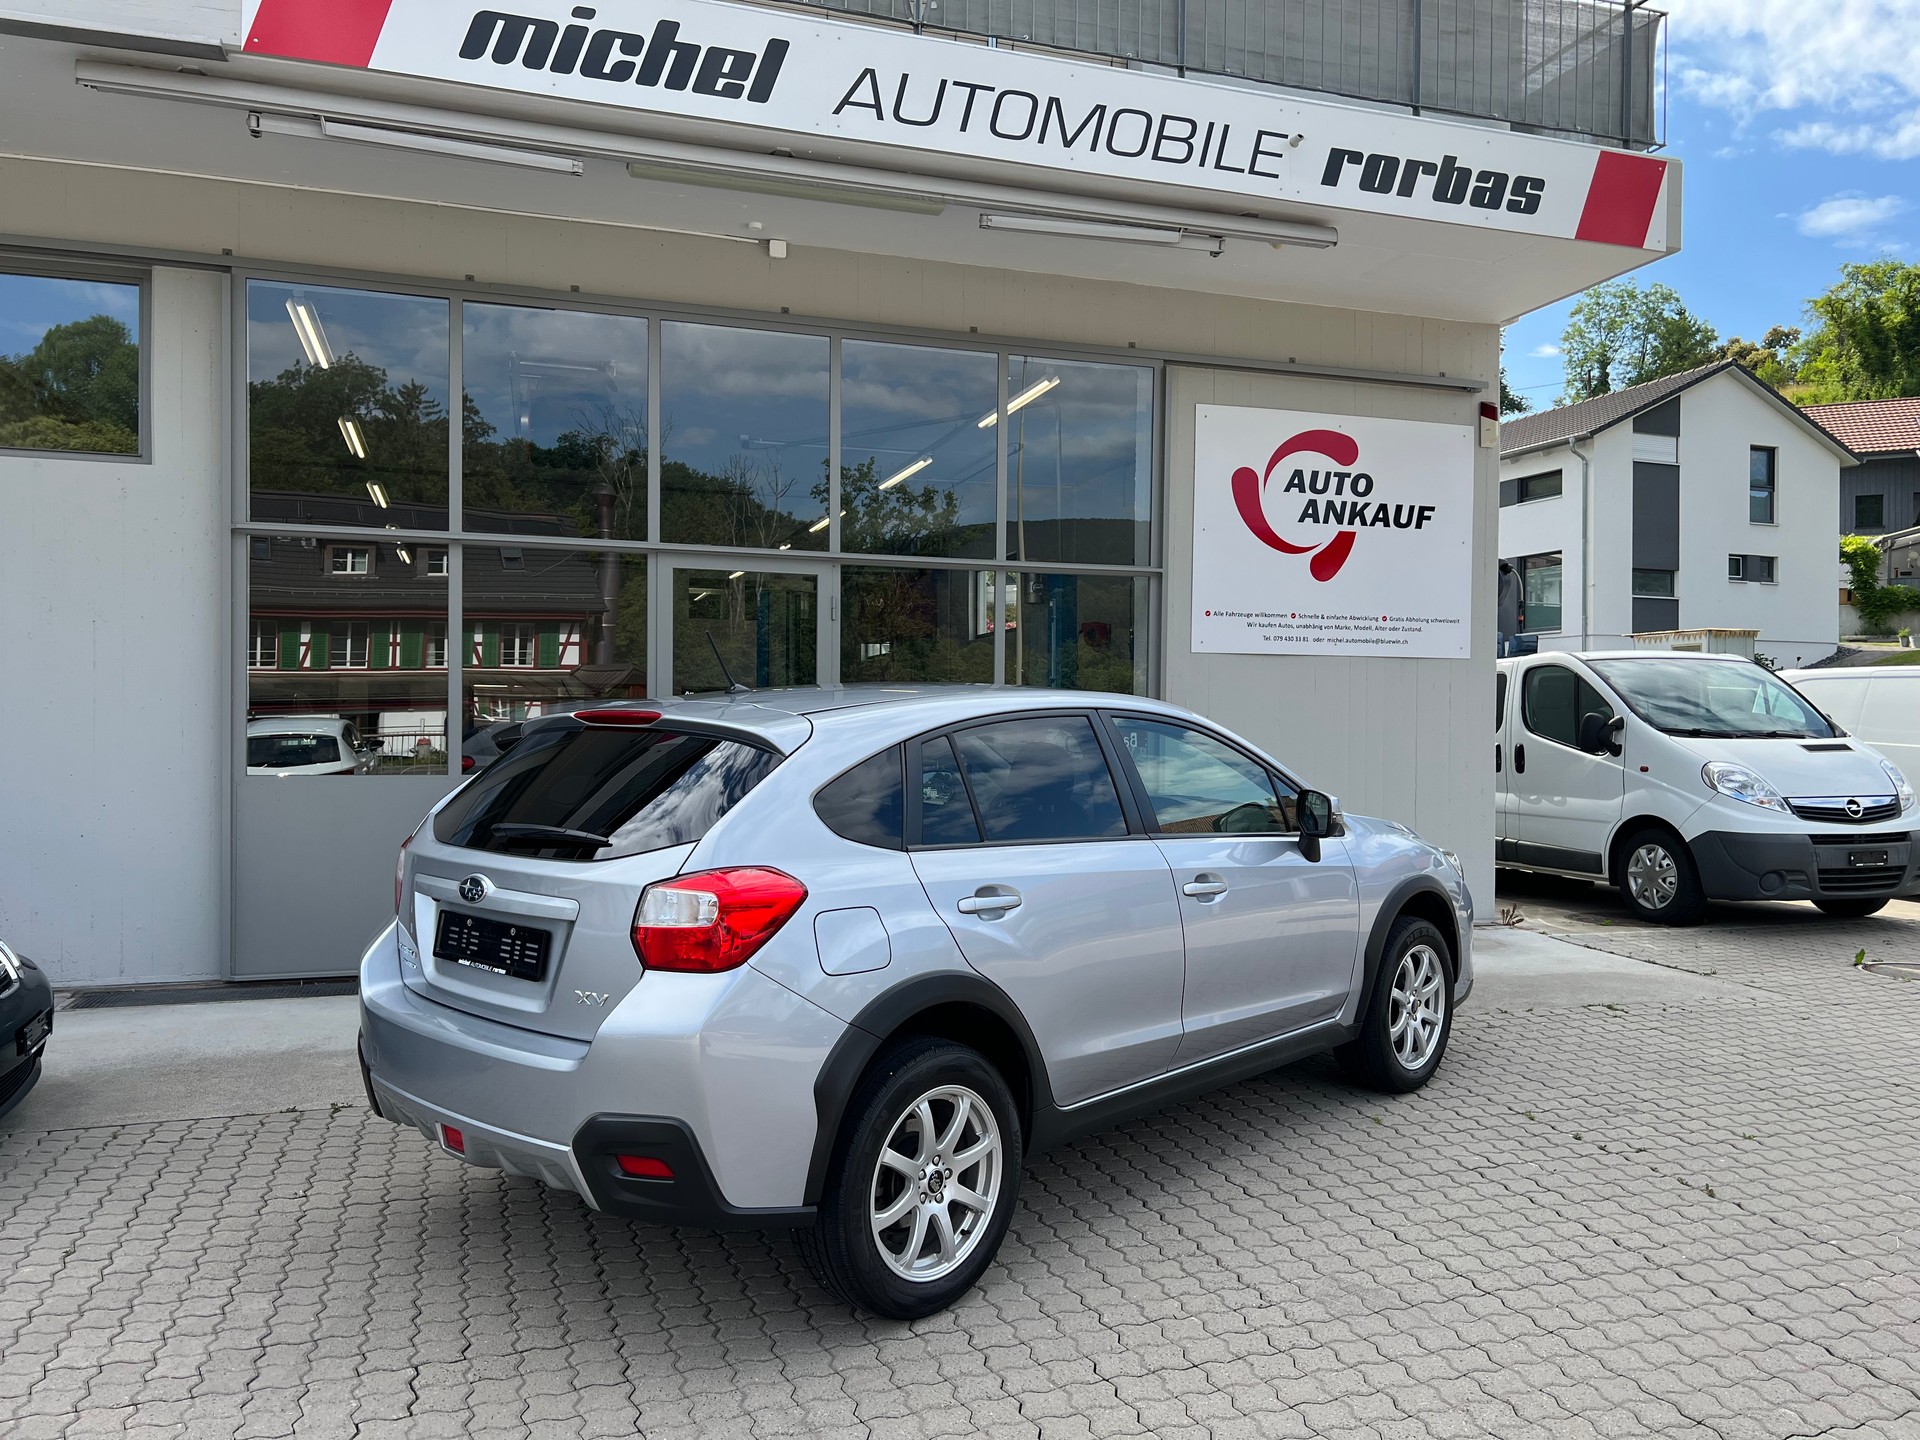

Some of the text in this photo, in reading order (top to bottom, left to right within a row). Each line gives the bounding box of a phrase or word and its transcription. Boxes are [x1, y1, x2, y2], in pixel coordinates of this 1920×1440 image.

[458, 6, 1546, 216] michel AUTOMOBILE rorbas
[1283, 469, 1374, 498] AUTO
[1297, 498, 1436, 530] ANKAUF
[1225, 610, 1253, 618] Fahrzeuge
[574, 989, 610, 1007] XV
